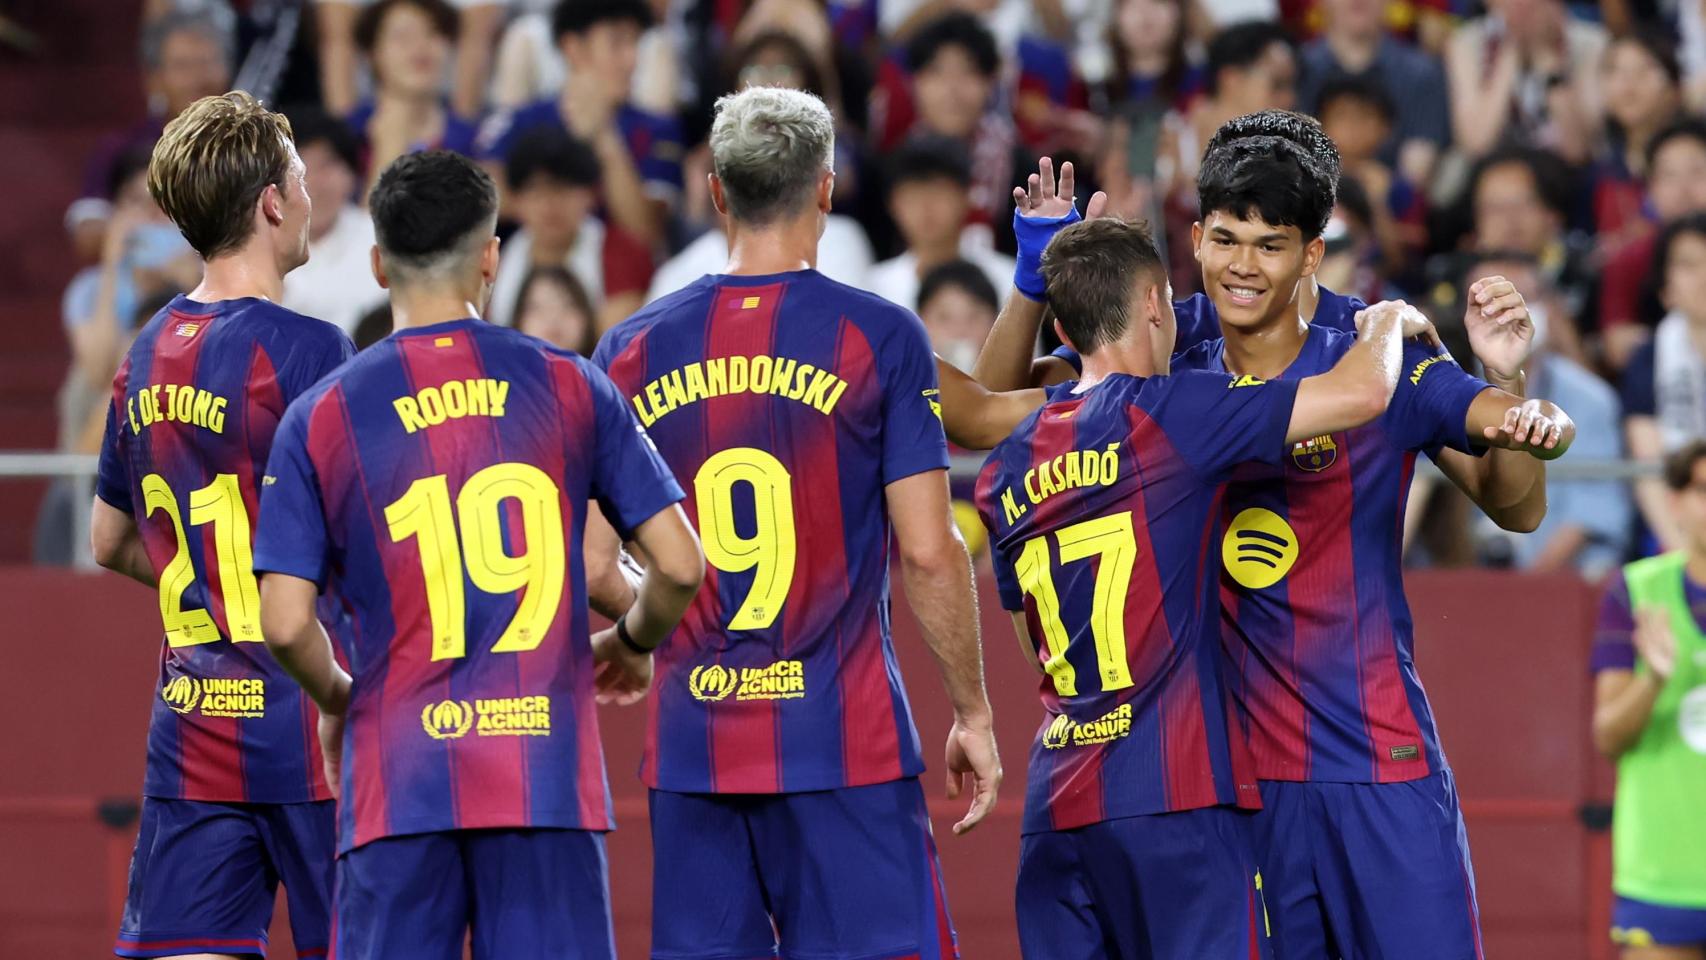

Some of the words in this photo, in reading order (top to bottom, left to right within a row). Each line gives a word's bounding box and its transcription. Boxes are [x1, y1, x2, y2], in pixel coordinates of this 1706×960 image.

[139, 384, 164, 427] DE
[164, 384, 228, 434] JONG
[393, 379, 509, 433] ROONY
[634, 355, 848, 428] LEWANDOWSKI
[1024, 442, 1120, 504] CASADÓ
[141, 473, 266, 648] 21
[384, 462, 566, 662] 19
[694, 447, 796, 631] 9
[1014, 511, 1137, 697] 17
[201, 695, 264, 710] ACNUR
[203, 679, 264, 695] UNHCR
[475, 696, 550, 715] UNHCR
[736, 676, 805, 696] ACNUR
[476, 712, 551, 730] ACNUR
[1073, 718, 1131, 740] ACNUR
